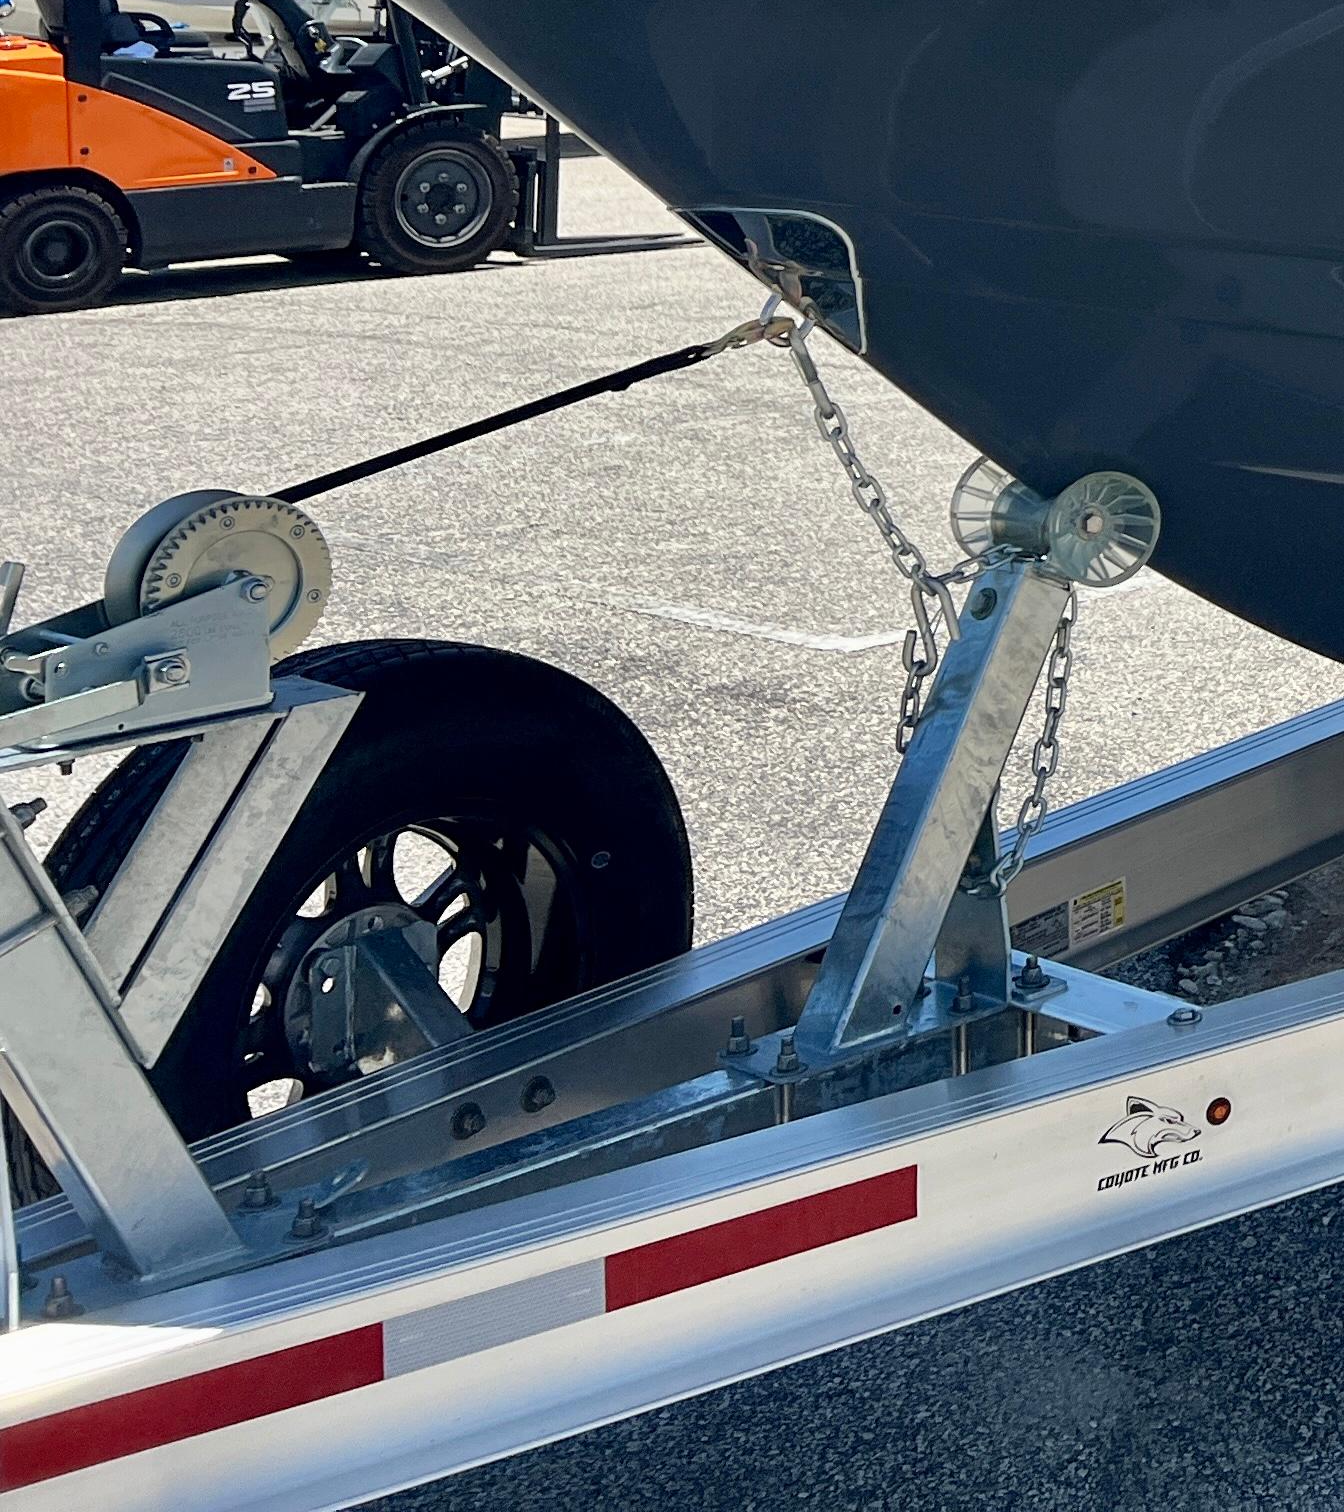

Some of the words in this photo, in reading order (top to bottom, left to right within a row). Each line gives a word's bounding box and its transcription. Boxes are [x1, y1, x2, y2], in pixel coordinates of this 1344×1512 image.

[227, 81, 275, 100] 25
[1098, 1165, 1150, 1191] COYOTE
[1153, 1155, 1180, 1174] MFG
[1183, 1149, 1203, 1165] CO.
